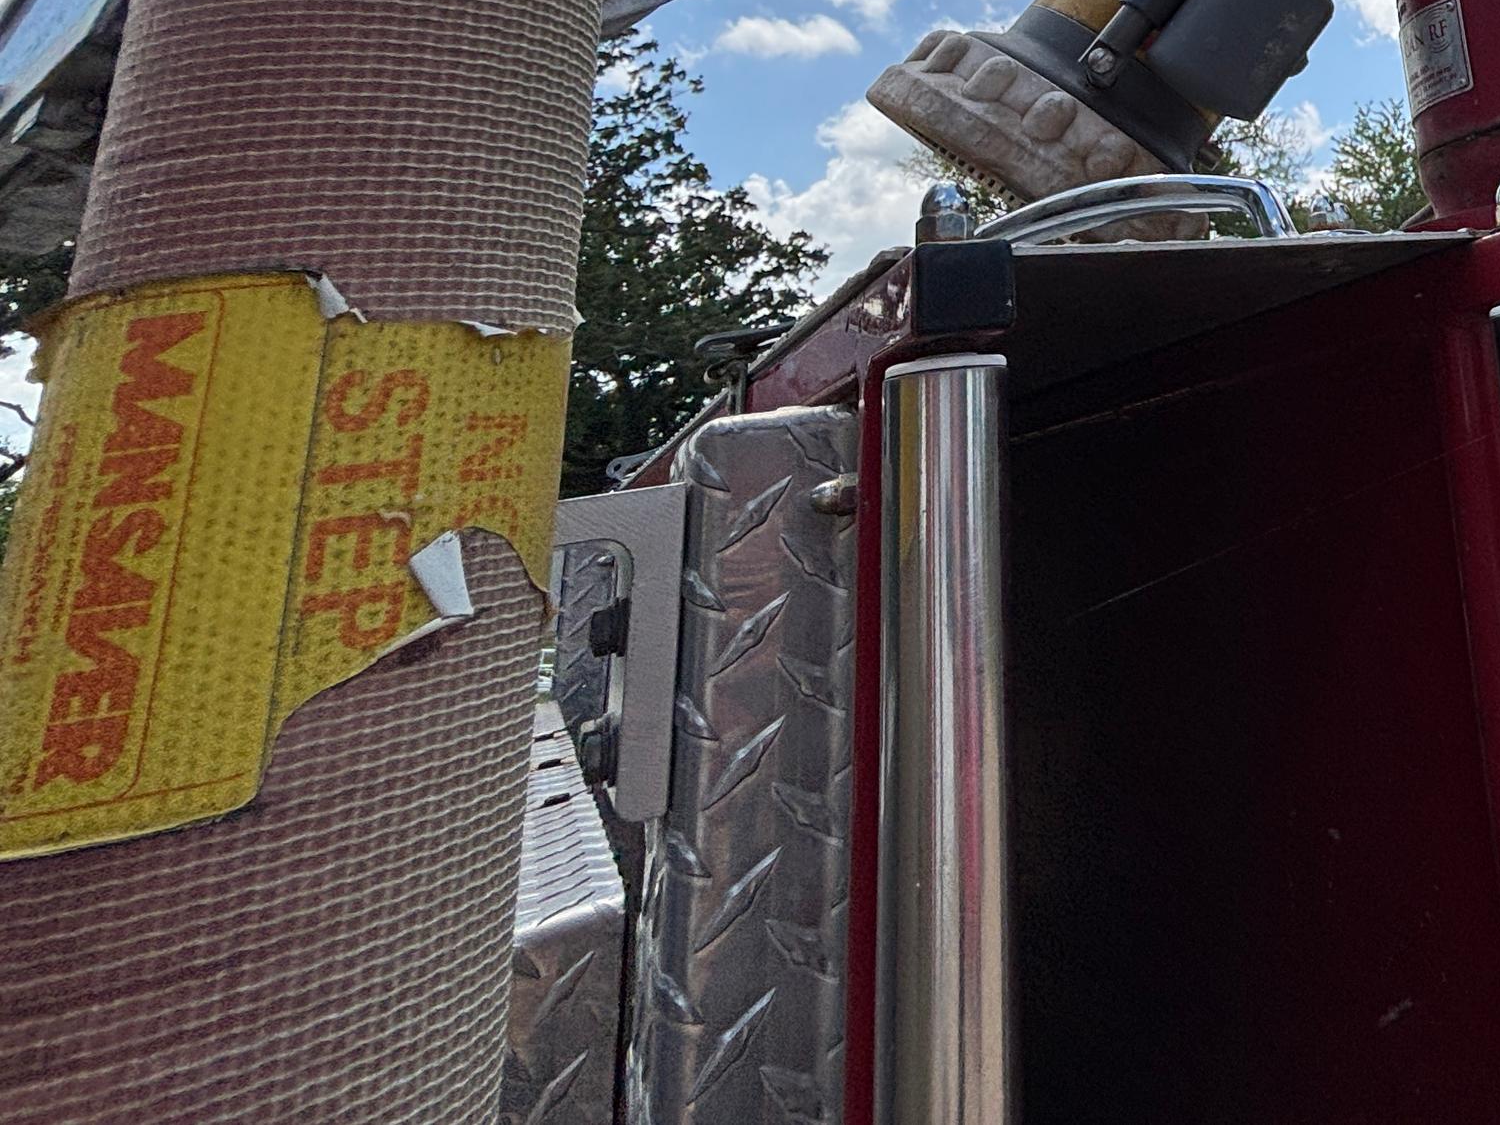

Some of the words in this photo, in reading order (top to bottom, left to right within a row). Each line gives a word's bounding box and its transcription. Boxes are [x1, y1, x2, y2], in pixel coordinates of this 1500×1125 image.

[1428, 19, 1448, 41] RF
[33, 311, 208, 792] MANSAVER
[300, 368, 431, 651] STEP
